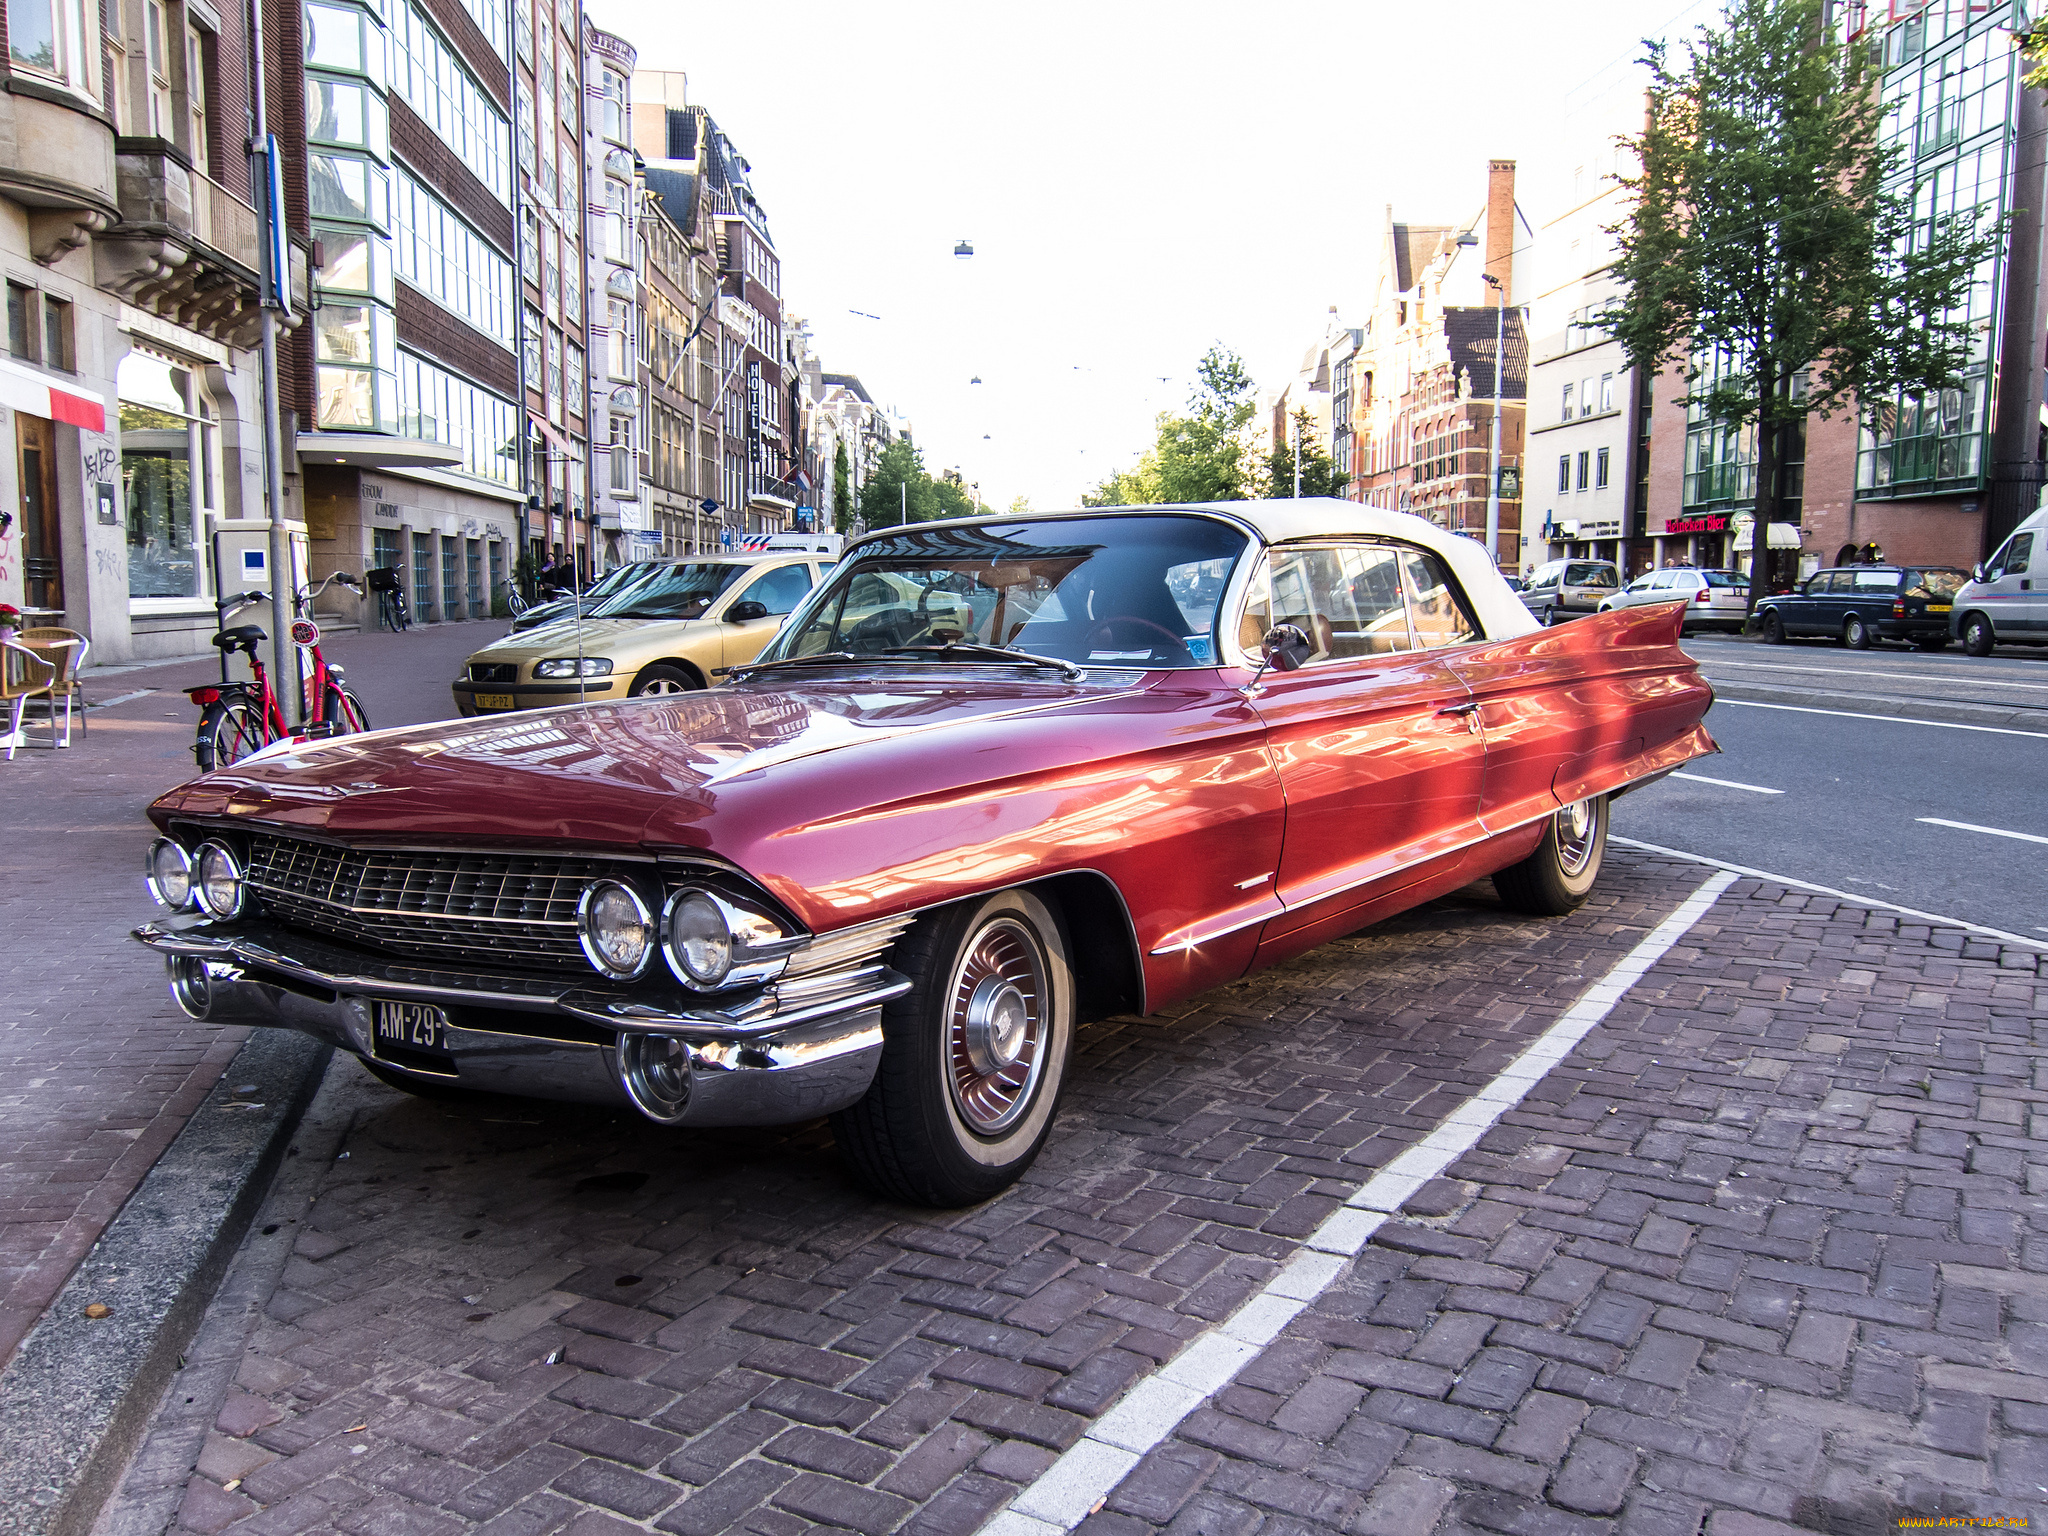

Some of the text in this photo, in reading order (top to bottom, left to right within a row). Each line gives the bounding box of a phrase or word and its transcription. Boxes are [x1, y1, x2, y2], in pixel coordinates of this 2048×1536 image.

[750, 364, 759, 430] HOTEL
[1665, 516, 1706, 534] Heineken
[1706, 514, 1726, 530] Bier
[295, 625, 313, 633] Mac
[292, 632, 311, 642] Bike
